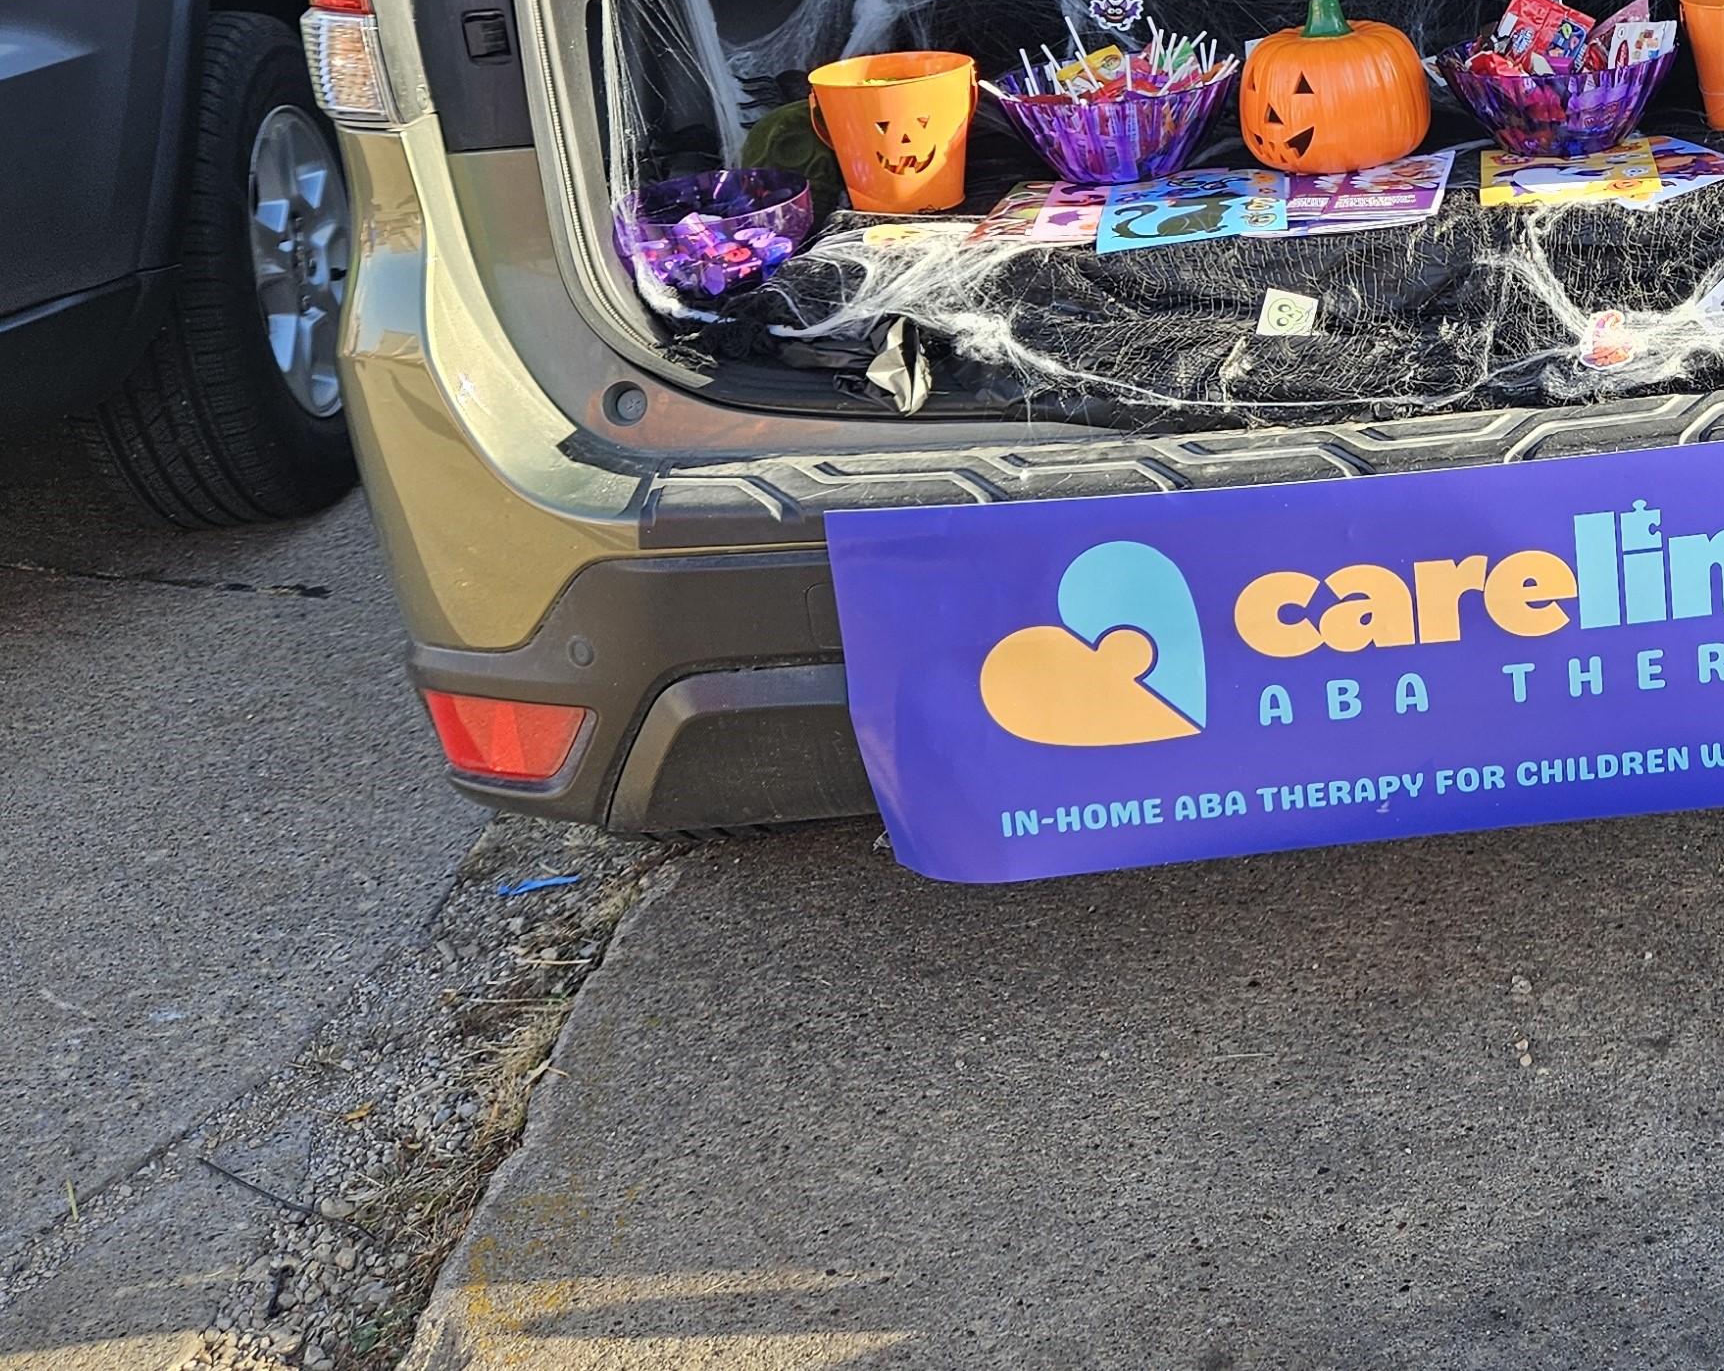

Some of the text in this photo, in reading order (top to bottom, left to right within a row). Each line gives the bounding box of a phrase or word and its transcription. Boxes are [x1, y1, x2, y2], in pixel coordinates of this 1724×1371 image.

[1259, 673, 1429, 726] ABA
[1001, 797, 1164, 838] IN-HOME
[1174, 790, 1247, 821] ABA
[1256, 772, 1425, 812] THERAPY
[1436, 766, 1505, 796] FOR
[1516, 745, 1690, 786] CHILDREN
